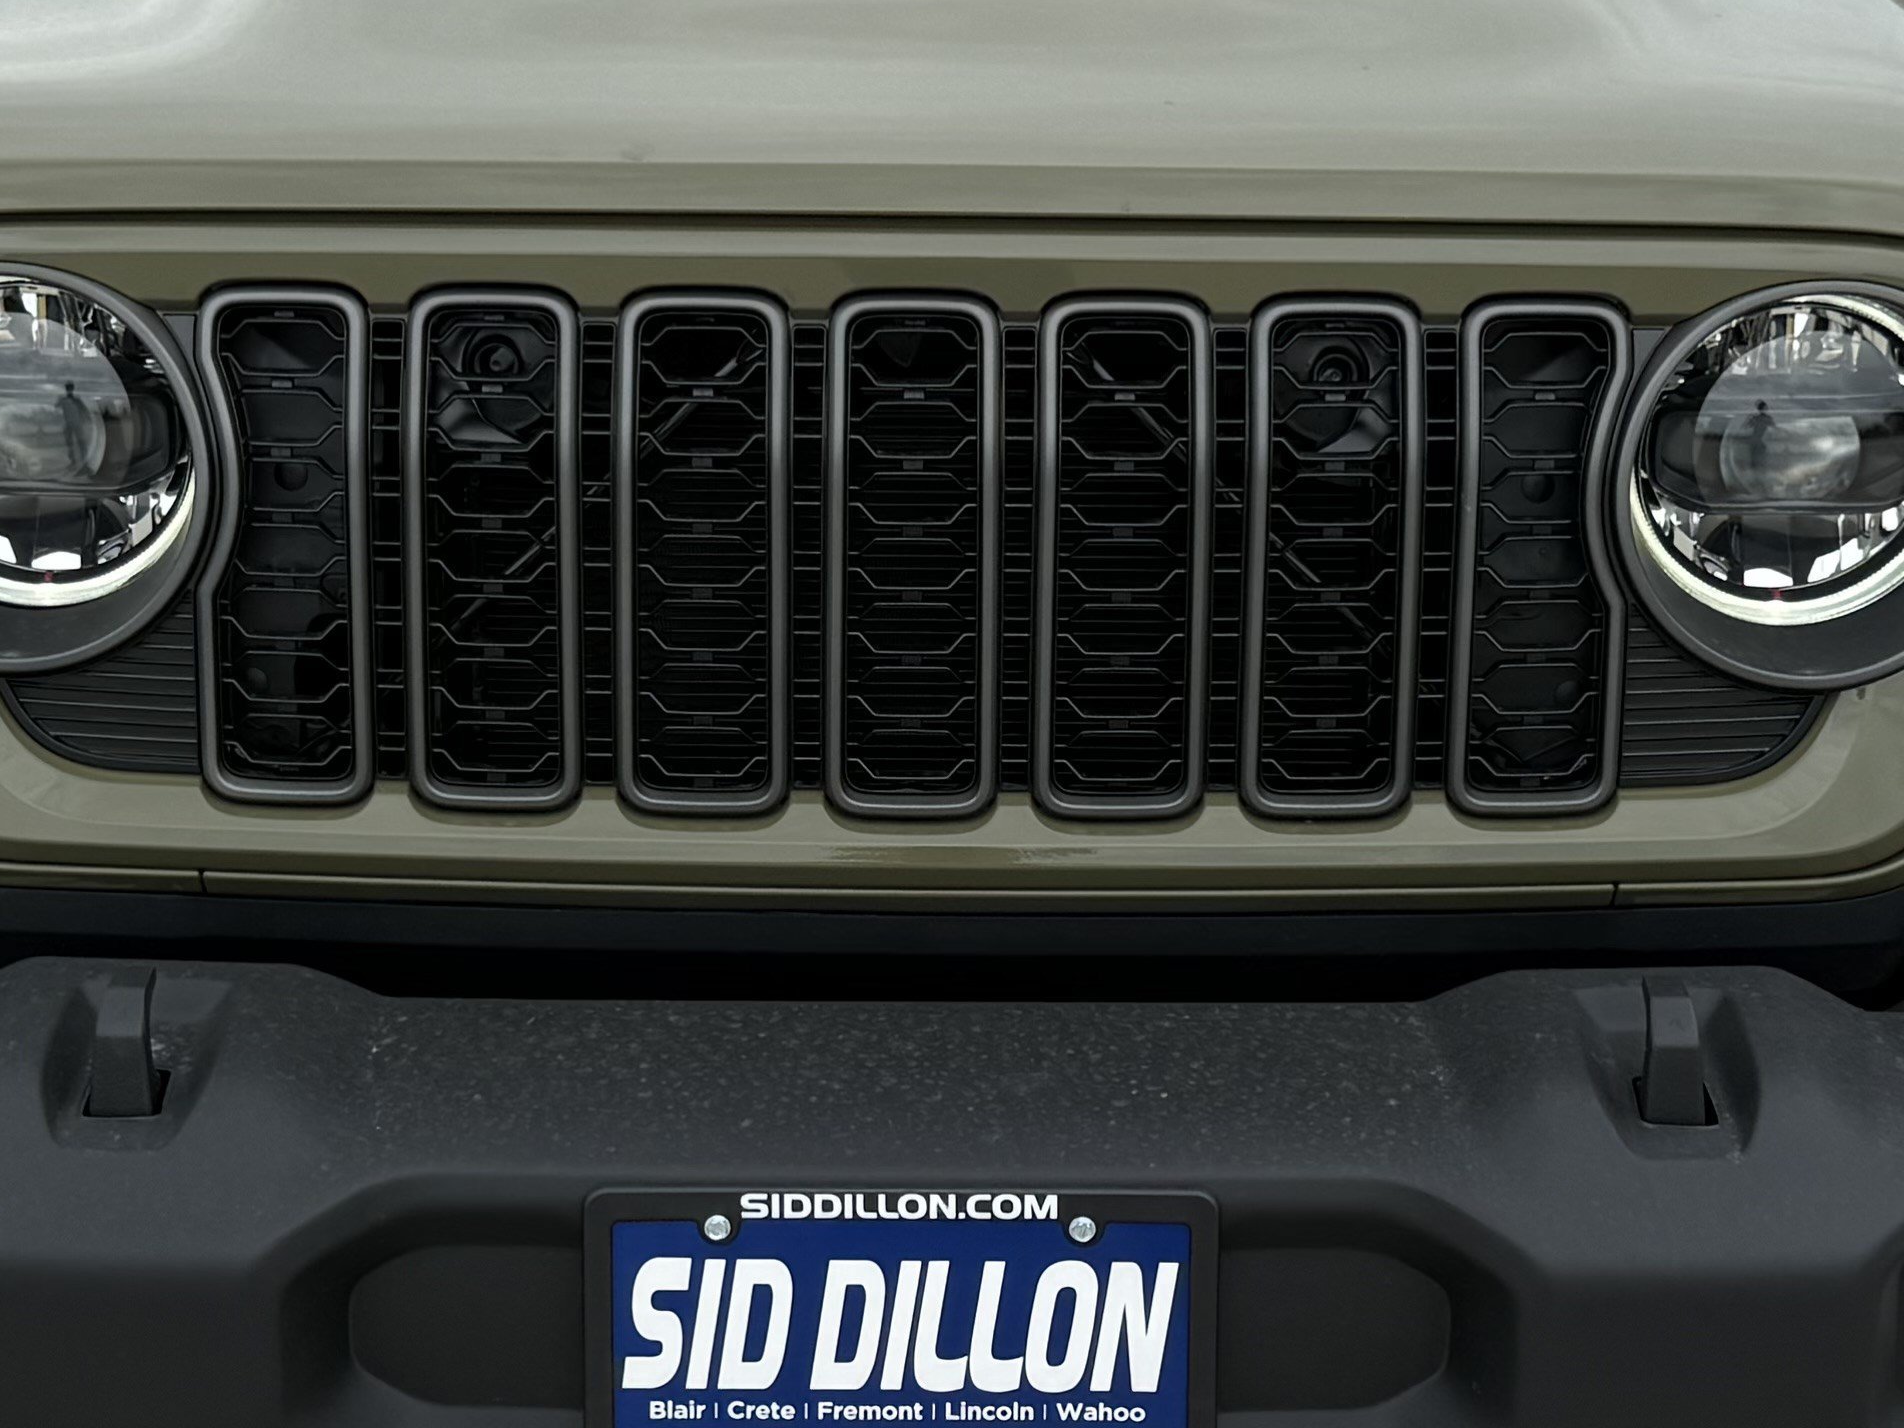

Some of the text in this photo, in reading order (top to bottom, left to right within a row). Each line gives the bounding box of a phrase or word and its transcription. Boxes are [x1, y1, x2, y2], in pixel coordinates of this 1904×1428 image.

[741, 1193, 1057, 1219] SIDDILLON.COM
[622, 1257, 1179, 1393] SID DILLON
[650, 1400, 1145, 1422] Blair Crete Fremont Lincoln Wahoo
